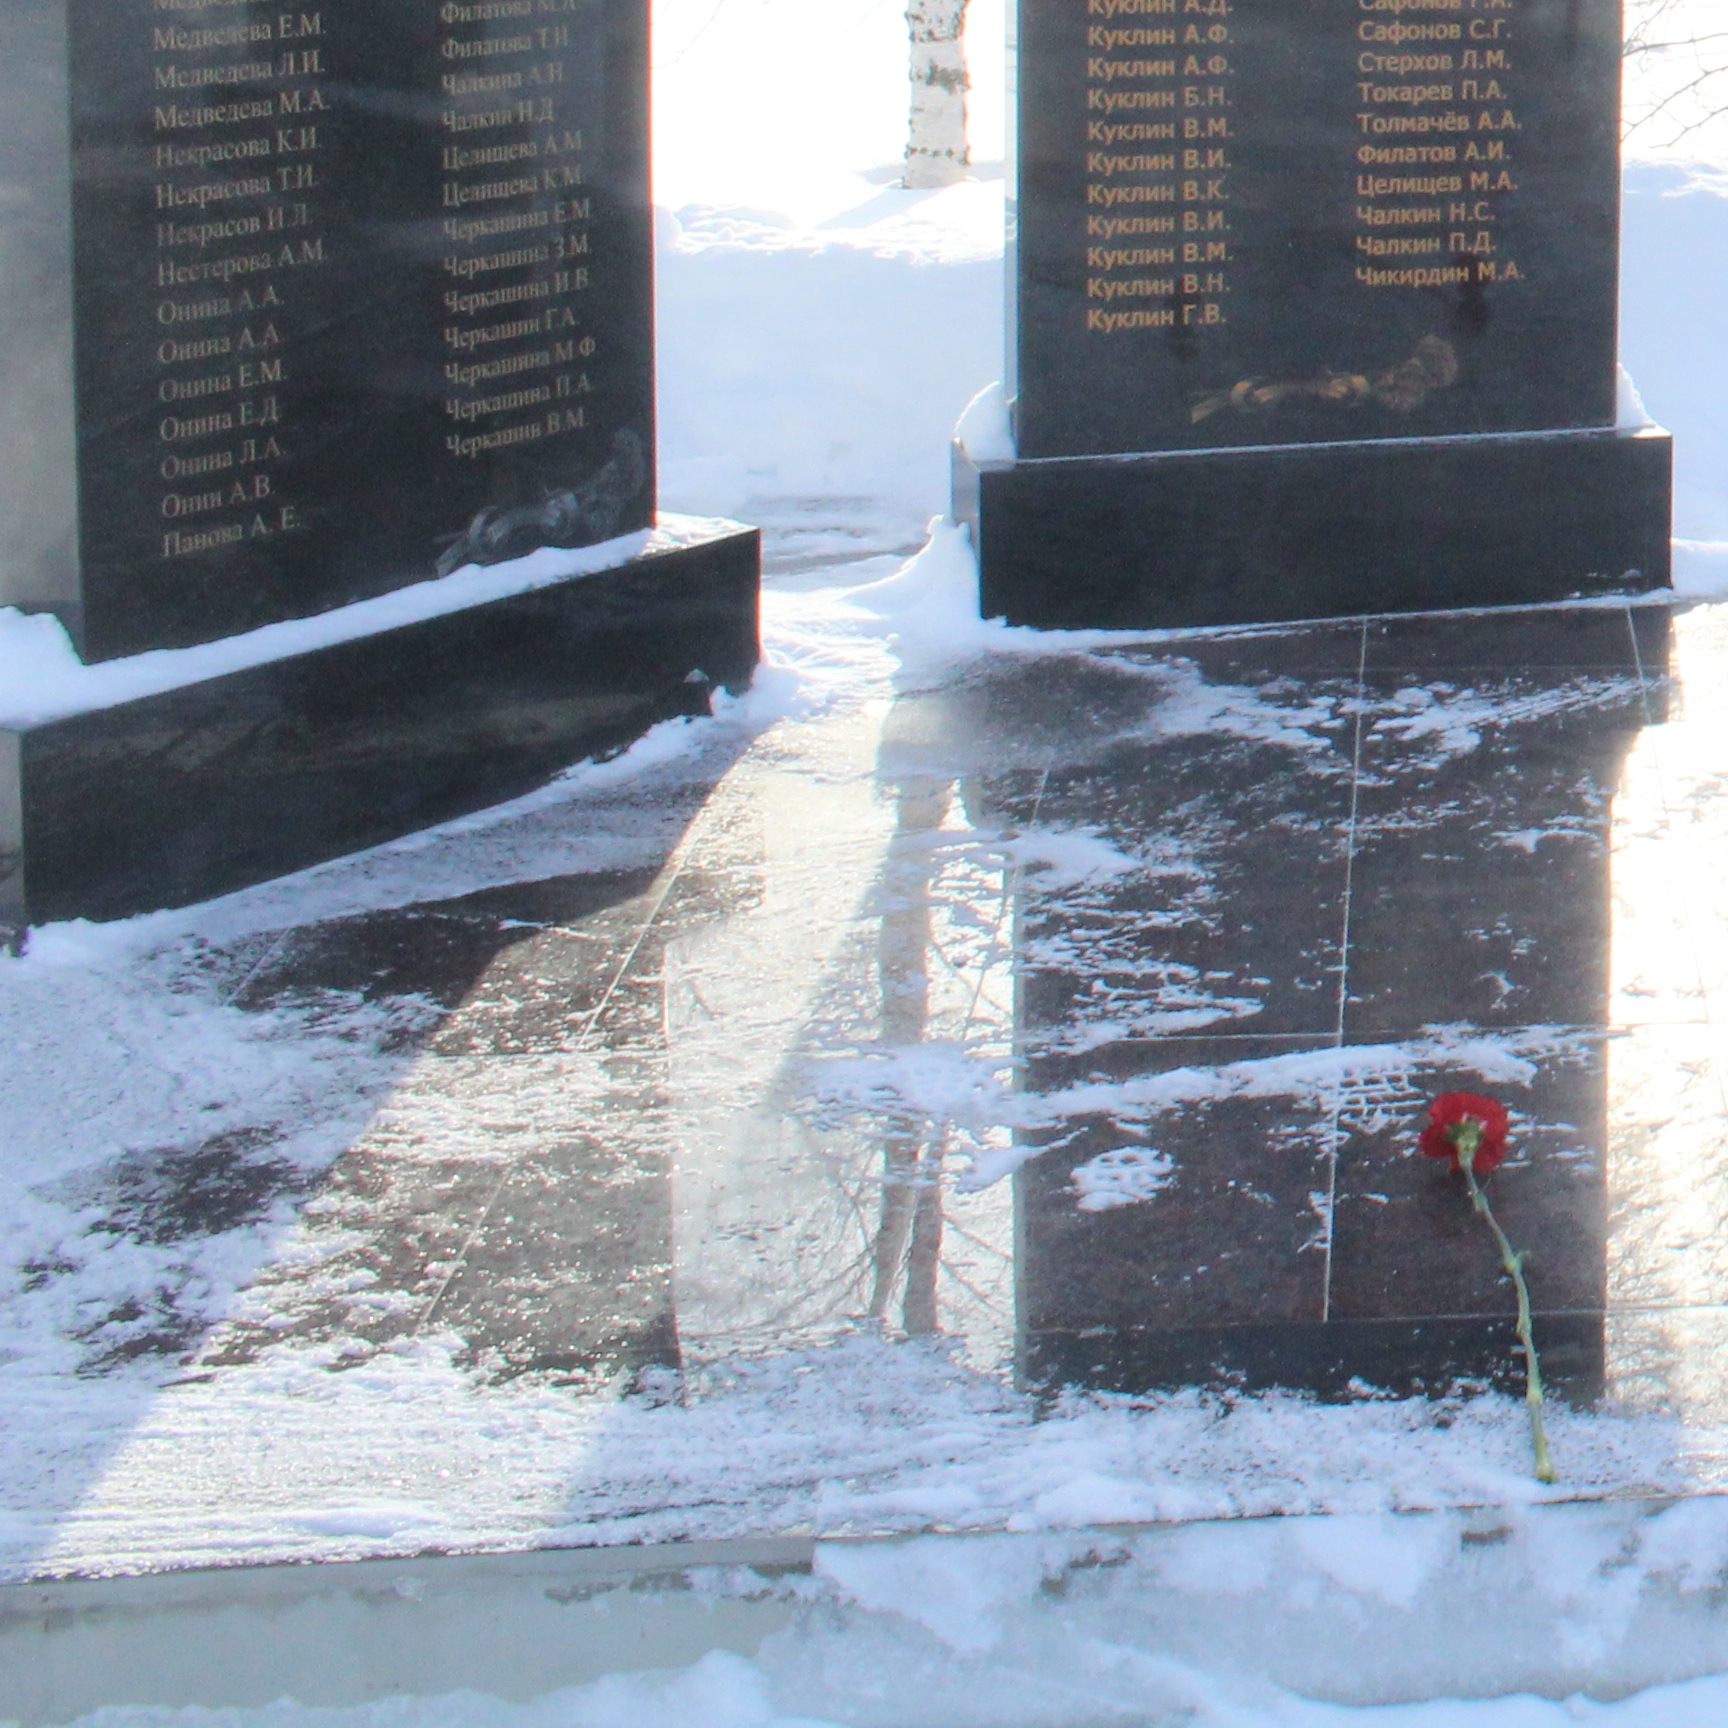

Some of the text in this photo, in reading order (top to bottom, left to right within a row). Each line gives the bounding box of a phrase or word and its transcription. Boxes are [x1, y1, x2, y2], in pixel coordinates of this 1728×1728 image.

[1358, 18, 1511, 42] Сафонов С.Г.
[1357, 49, 1510, 72] Стерхов Л.М.
[1358, 79, 1506, 103] Токарев П.А.
[154, 101, 272, 128] Медведева
[1357, 110, 1521, 132] Толмачёв А.А.
[1087, 176, 1229, 205] Куклин В.К.
[1357, 170, 1517, 195] Целищев М.А.
[1356, 231, 1495, 254] Чалкин П.Д.
[1355, 261, 1524, 286] Чикирдин М.А.
[1087, 303, 1226, 332] Куклин Г.В.
